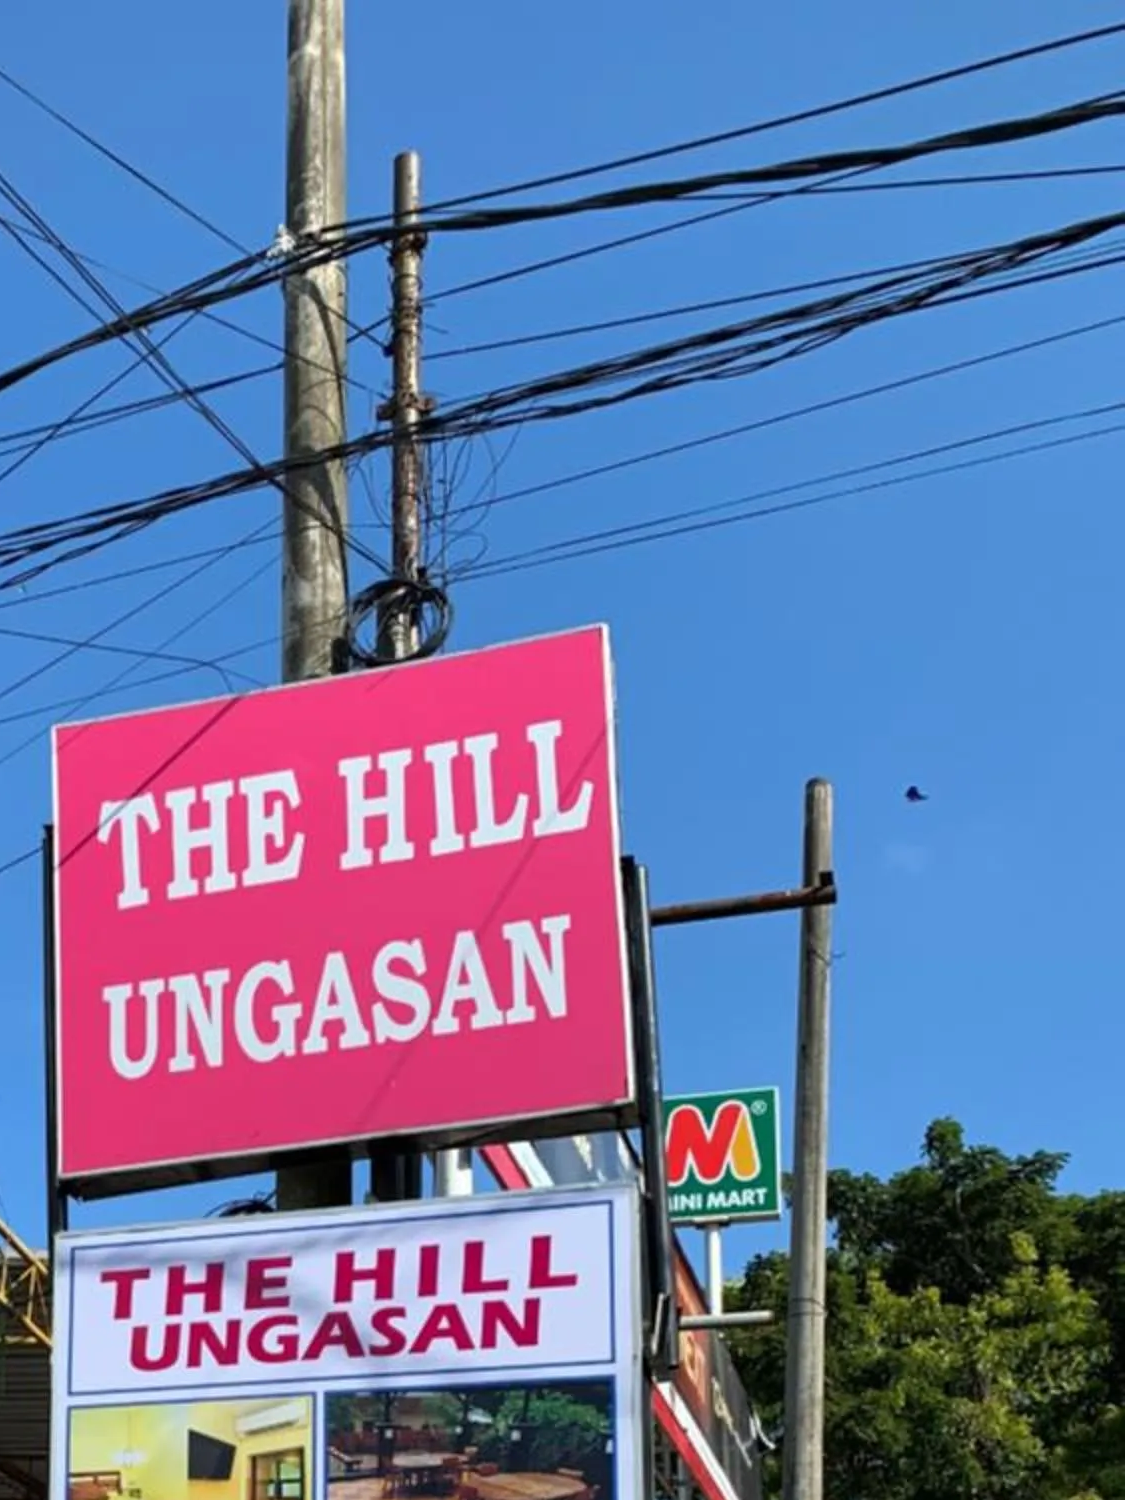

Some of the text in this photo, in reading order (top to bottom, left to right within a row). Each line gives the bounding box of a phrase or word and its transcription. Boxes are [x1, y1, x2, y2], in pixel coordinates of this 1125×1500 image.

[97, 719, 594, 910] THE HILL
[101, 914, 571, 1081] UNGASAN
[668, 1186, 768, 1213] INI MART
[99, 1234, 579, 1321] THE HILL
[129, 1297, 542, 1373] UNGASAN
